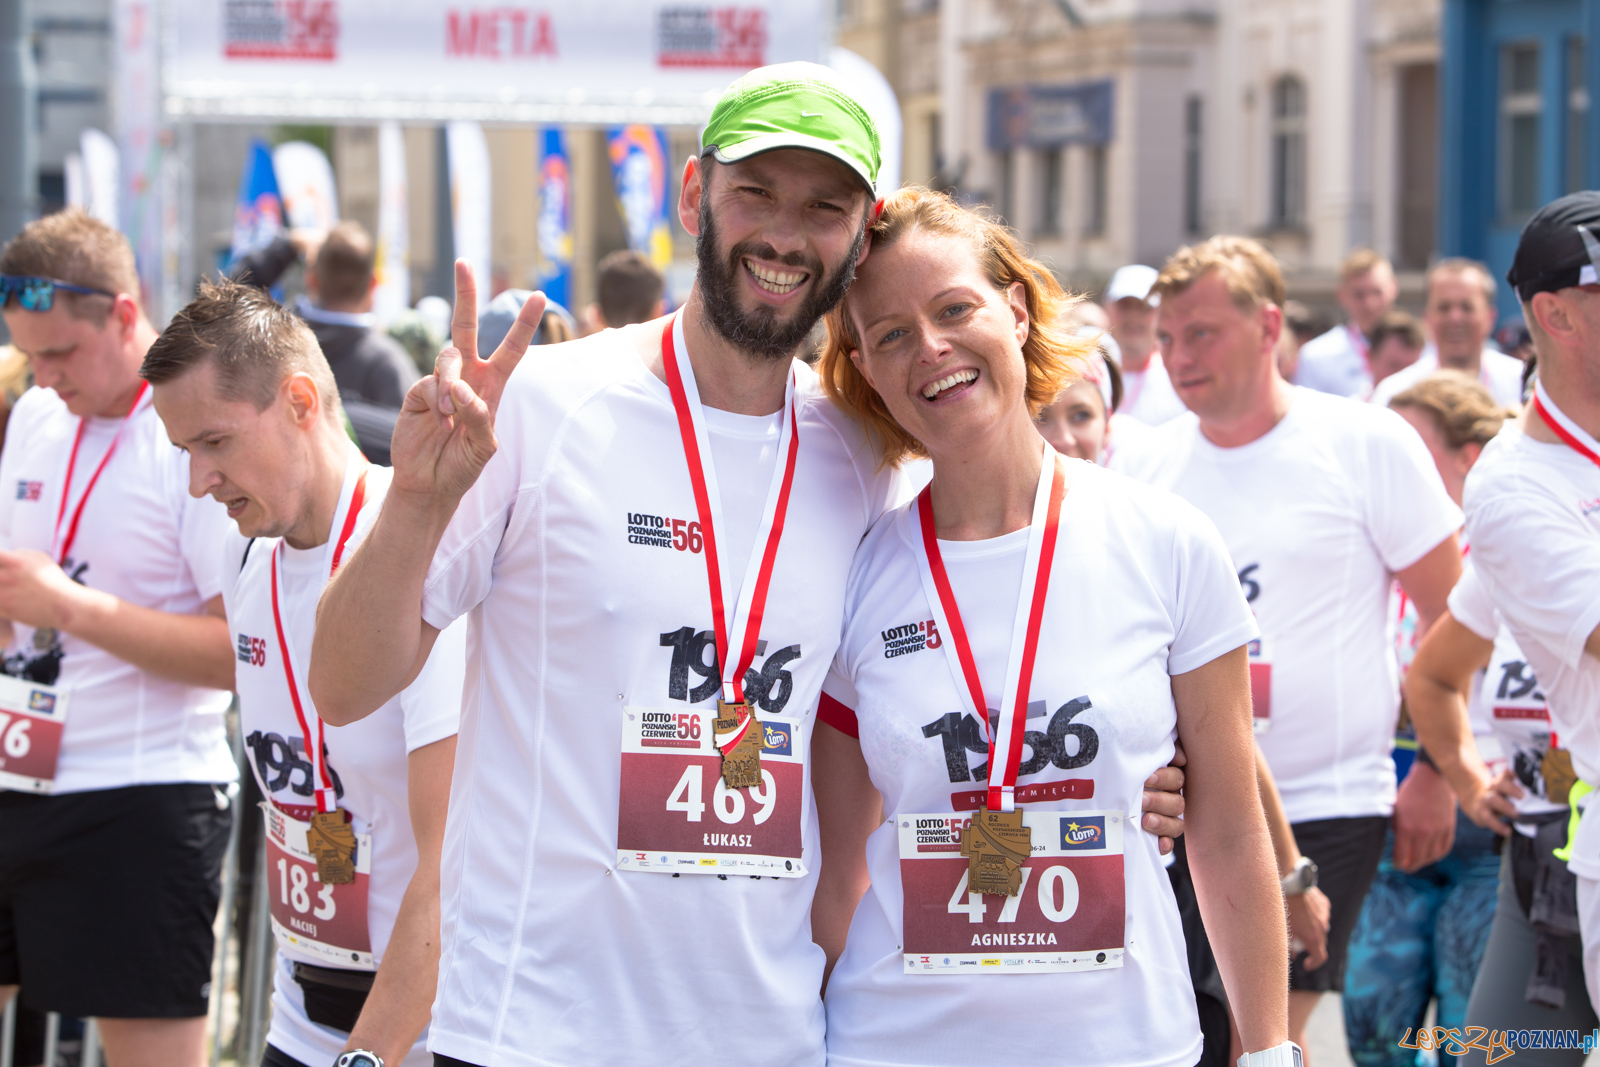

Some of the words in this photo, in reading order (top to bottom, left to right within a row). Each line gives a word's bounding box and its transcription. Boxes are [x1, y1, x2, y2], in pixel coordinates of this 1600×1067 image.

[446, 10, 557, 57] META
[627, 512, 664, 529] LOTTO
[627, 525, 672, 539] POZNAŃSKI
[627, 535, 673, 549] CZERWIEC
[881, 622, 918, 642] LOTTO
[918, 619, 943, 650] '5
[884, 633, 926, 650] POZNAŃSKI
[884, 641, 926, 659] CZERWIEC
[642, 712, 672, 723] LOTTO
[717, 717, 739, 730] POZNAŃ
[641, 722, 677, 731] POZNAŃSKI
[641, 730, 677, 739] CZERWIEC
[768, 734, 785, 745] LOTTO
[666, 764, 777, 826] 469
[916, 819, 945, 829] LOTTO
[916, 827, 950, 836] POZNAŃSKI
[1071, 828, 1095, 841] LOTTO
[702, 833, 753, 848] ŁUKASZ
[916, 835, 951, 843] CZERWIEC
[277, 857, 337, 921] 183
[947, 864, 1080, 924] 470
[970, 932, 1058, 947] AGNIESZKA
